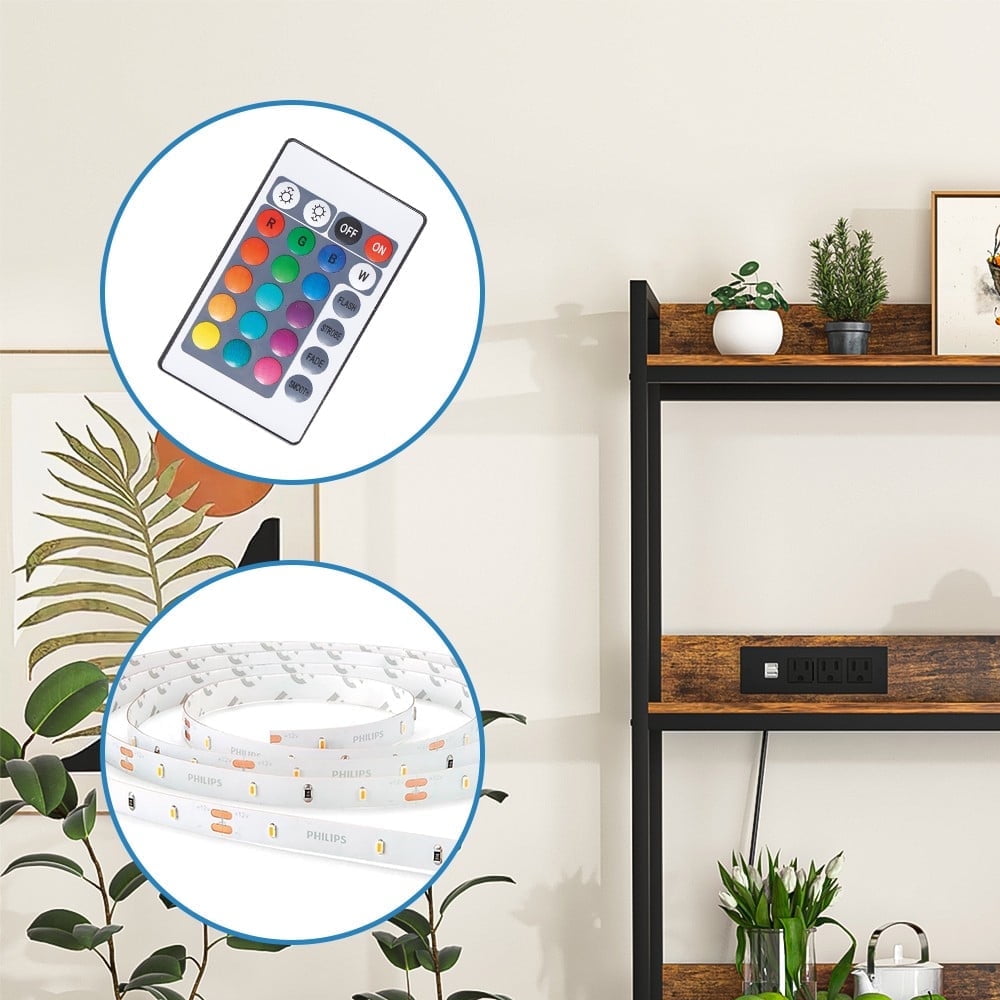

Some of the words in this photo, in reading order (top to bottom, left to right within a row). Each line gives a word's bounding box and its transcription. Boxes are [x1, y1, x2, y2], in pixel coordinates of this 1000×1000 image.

[266, 217, 276, 229] R
[340, 223, 359, 238] OFF
[297, 236, 307, 247] G
[372, 242, 387, 255] ON
[328, 254, 337, 265] B
[358, 270, 370, 282] W
[338, 296, 357, 312] FLASH
[320, 324, 342, 340] STROBE
[305, 353, 325, 368] FADE
[352, 731, 384, 743] PHILIPS
[188, 773, 223, 787] PHILIPS
[332, 769, 371, 778] PHILIPS
[306, 830, 347, 844] PHILIPS
